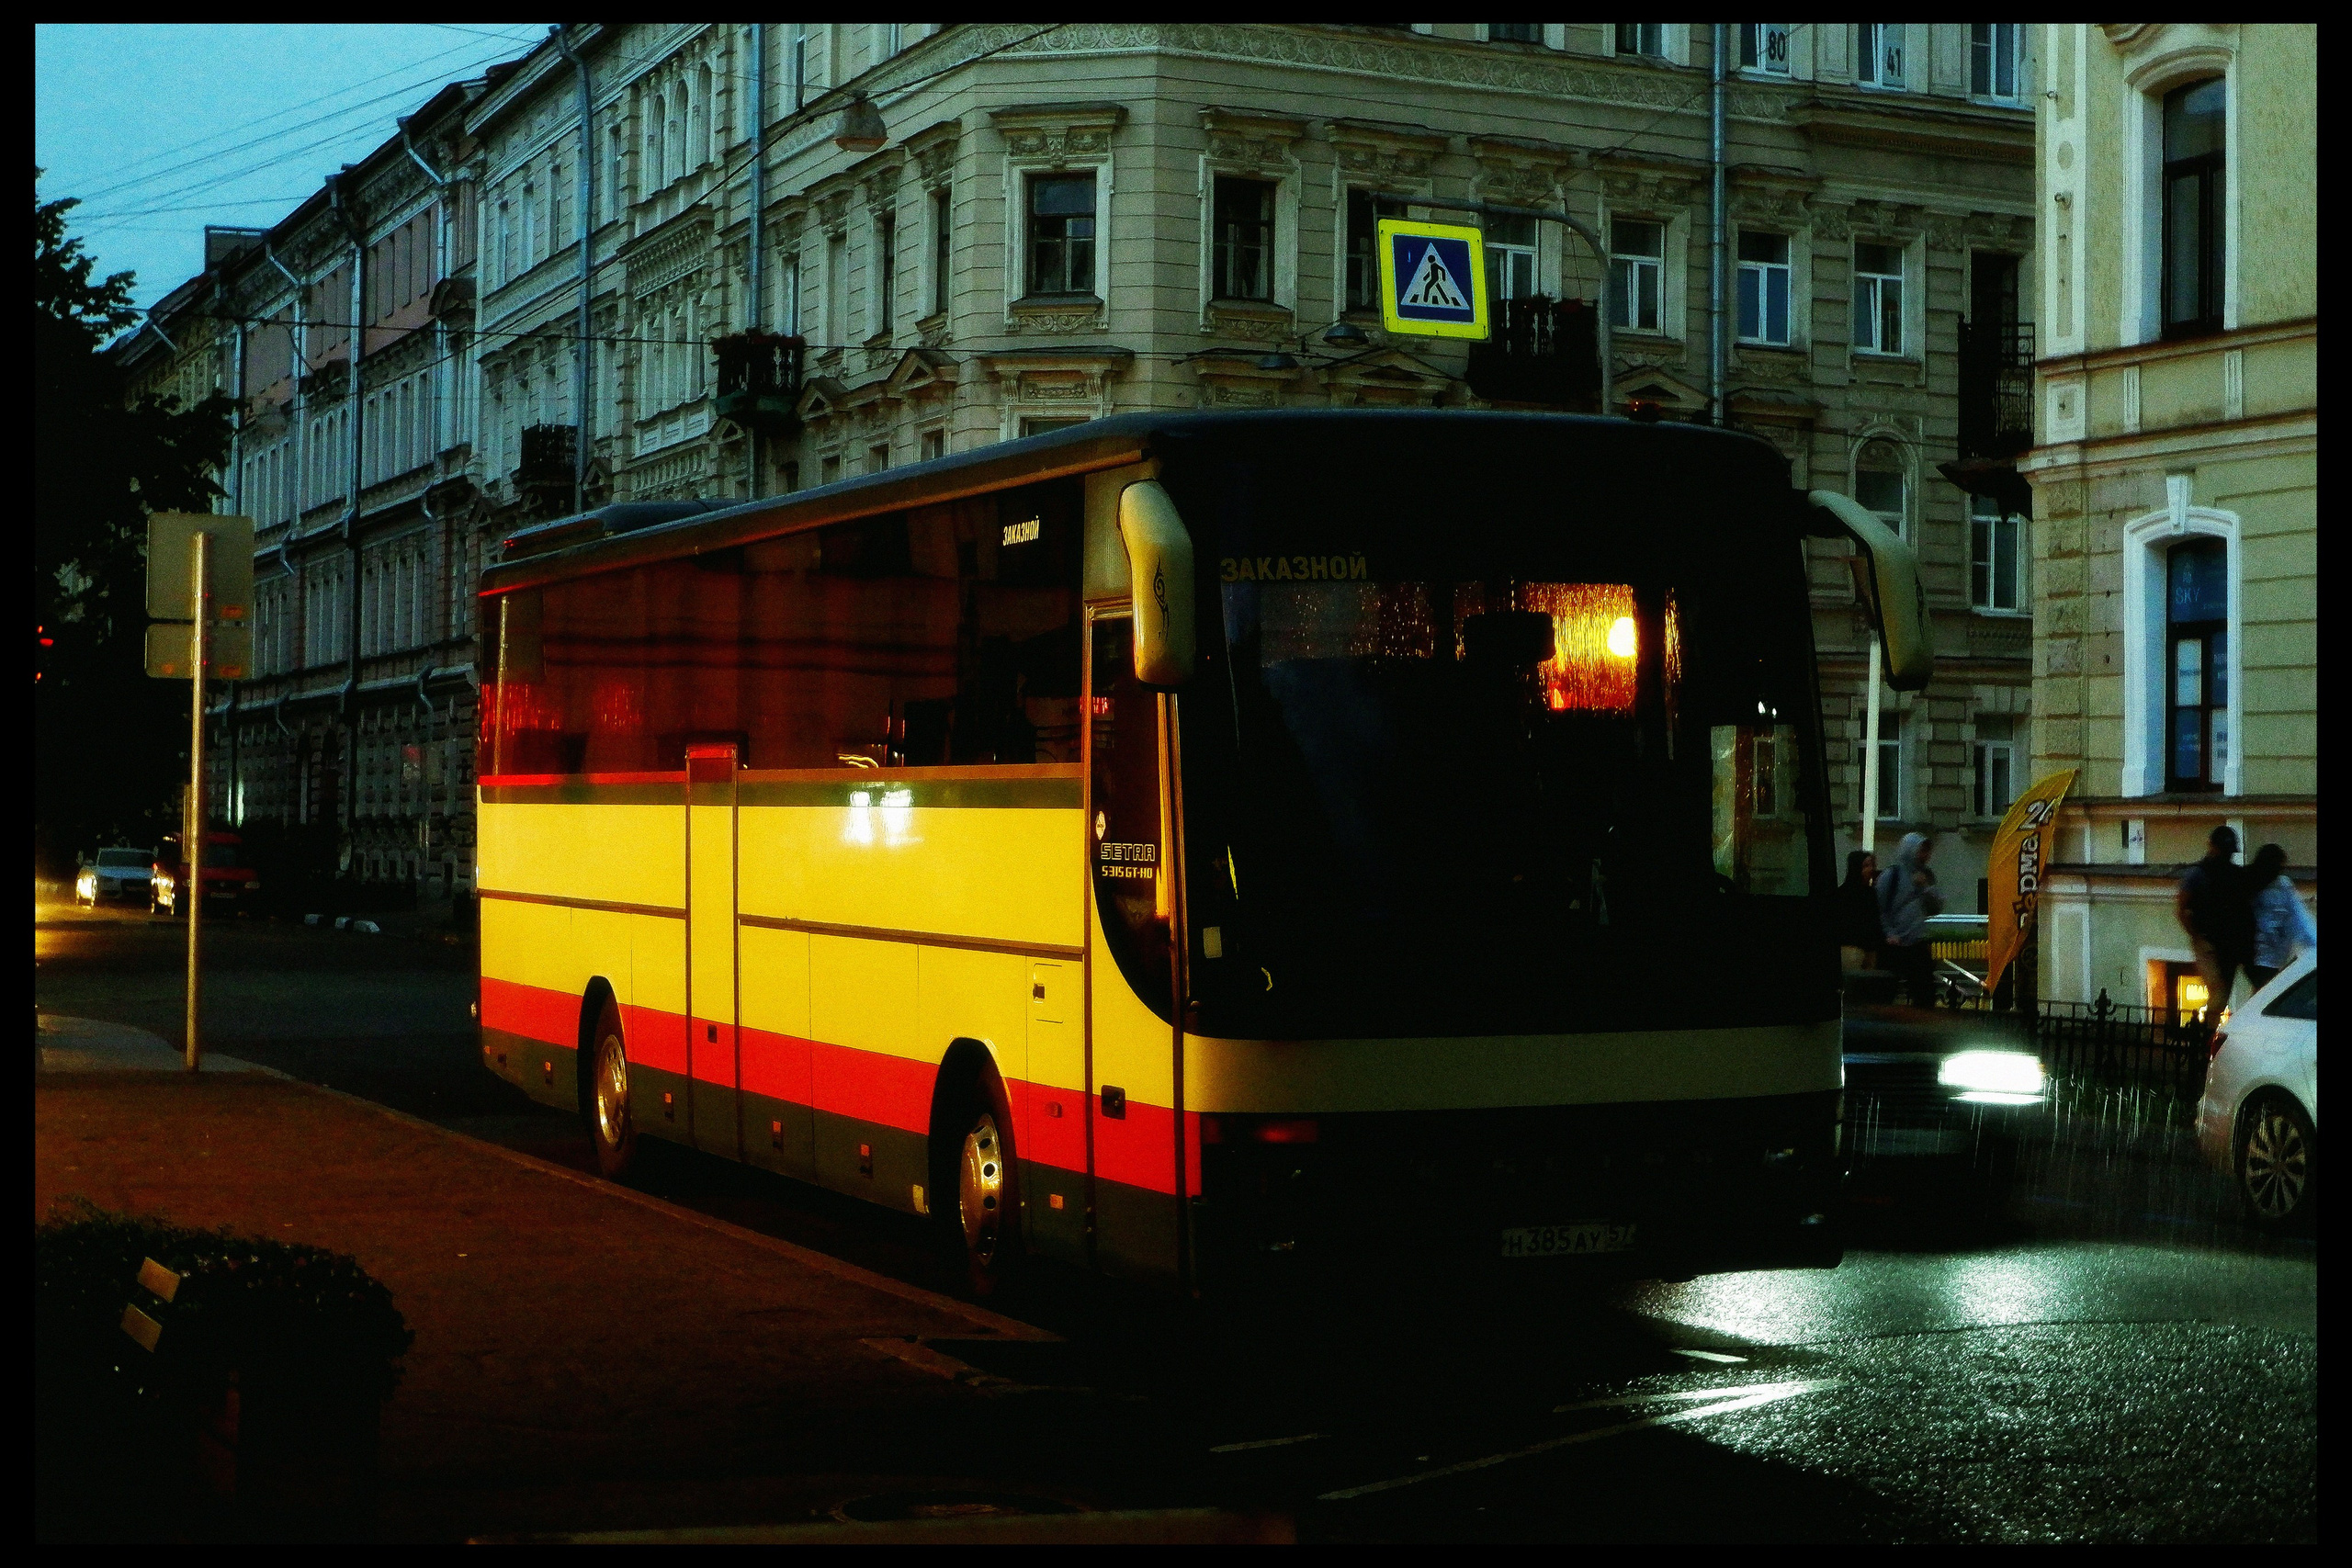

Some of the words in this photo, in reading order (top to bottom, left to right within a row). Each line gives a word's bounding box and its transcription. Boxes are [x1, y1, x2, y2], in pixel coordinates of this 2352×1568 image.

[1769, 30, 1786, 62] 80
[1887, 45, 1901, 77] 41
[1002, 514, 1040, 547] ЗАКАЗНОЙ
[1220, 551, 1367, 582] ЗАКАЗНОЙ
[2175, 586, 2200, 604] SKY
[1101, 842, 1156, 862] SETRA
